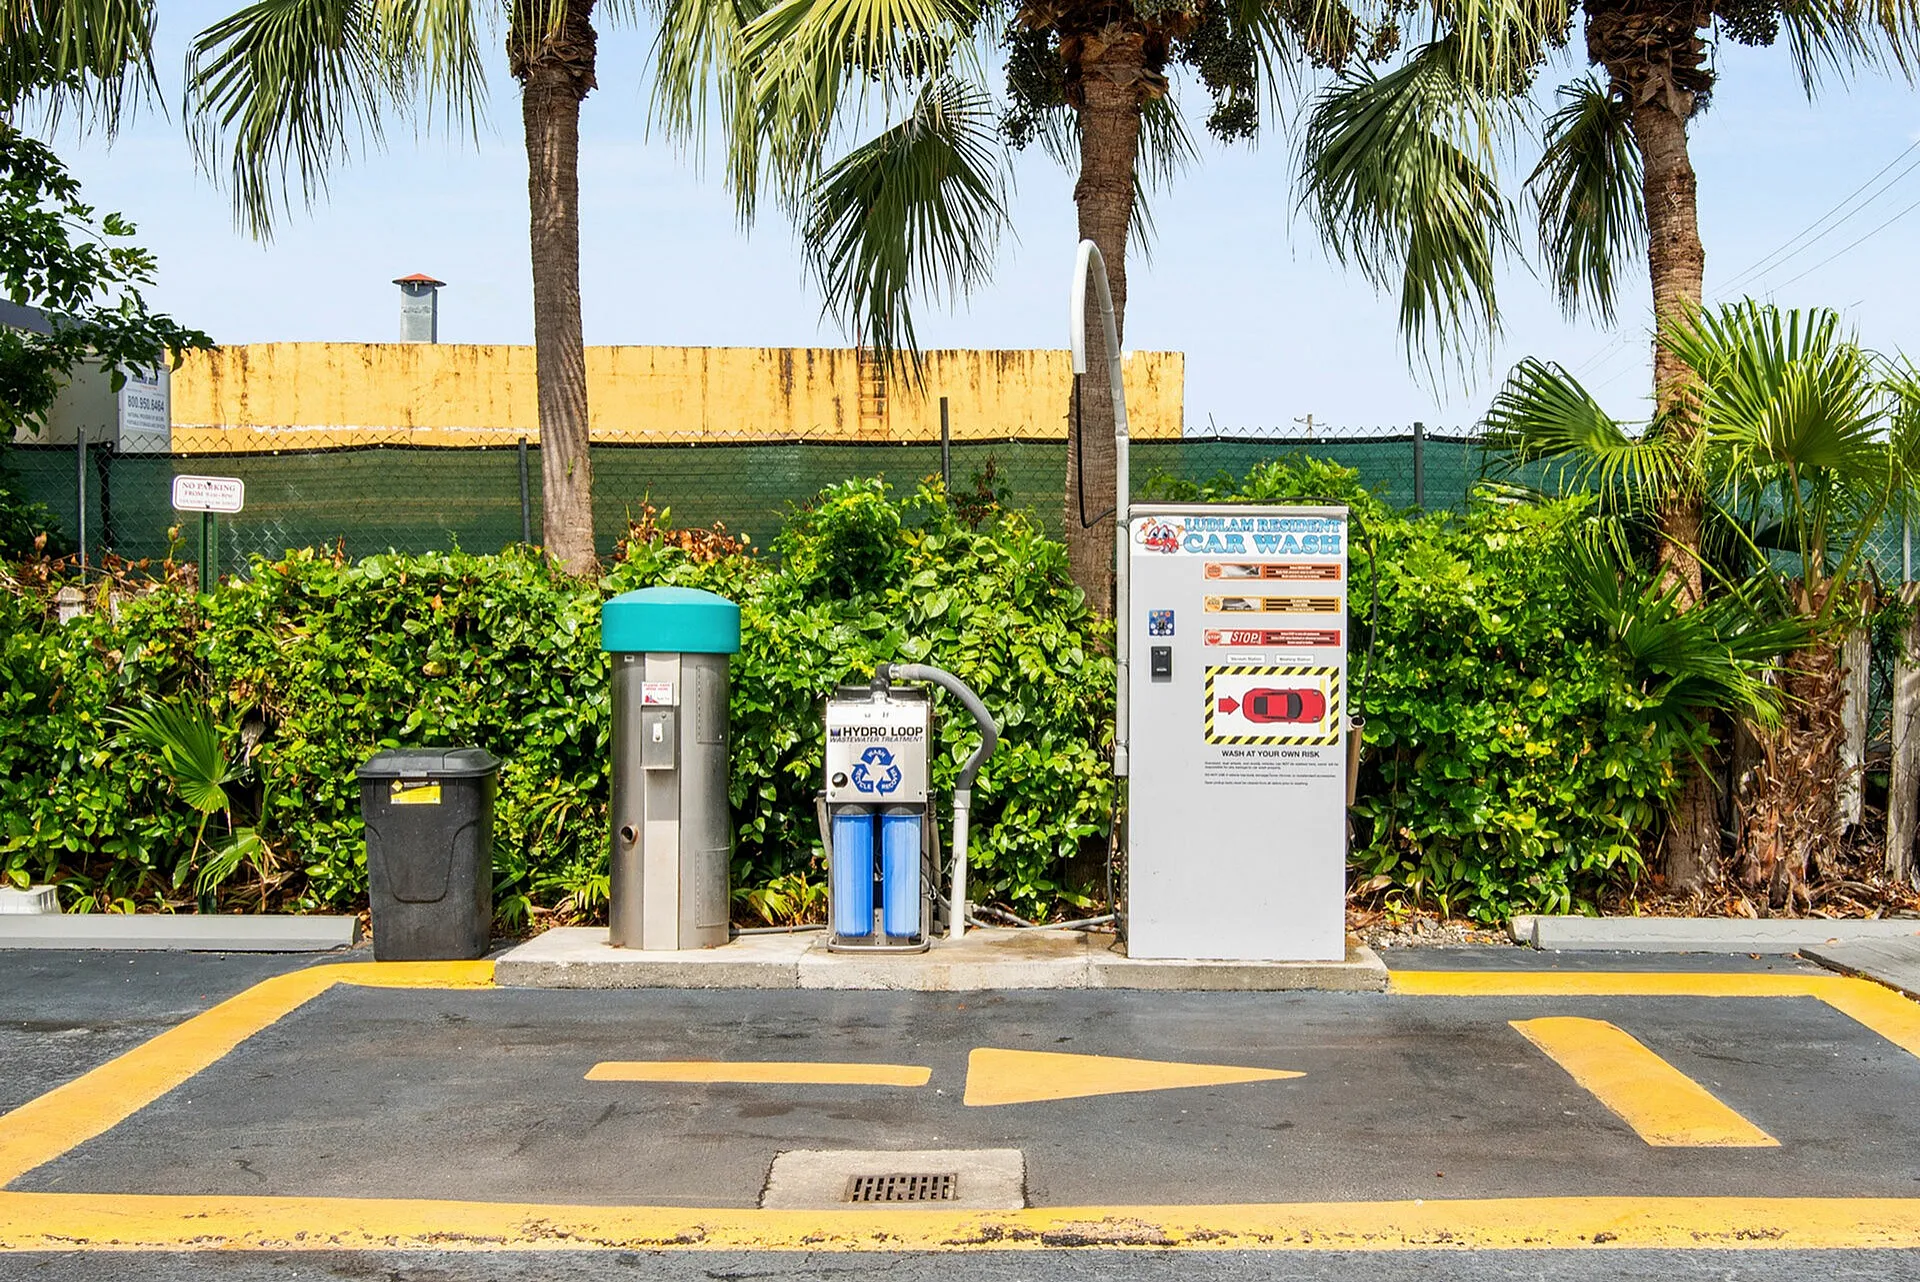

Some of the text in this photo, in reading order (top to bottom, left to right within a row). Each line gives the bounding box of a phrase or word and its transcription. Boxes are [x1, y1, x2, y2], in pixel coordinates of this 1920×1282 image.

[198, 483, 236, 491] PARKING
[1184, 518, 1341, 533] LUDLAM RESIDENT
[1183, 534, 1341, 554] CAR WASH
[843, 726, 923, 737] HYDRO LOOP
[868, 749, 886, 758] WASH
[855, 768, 872, 790] RECYCLE
